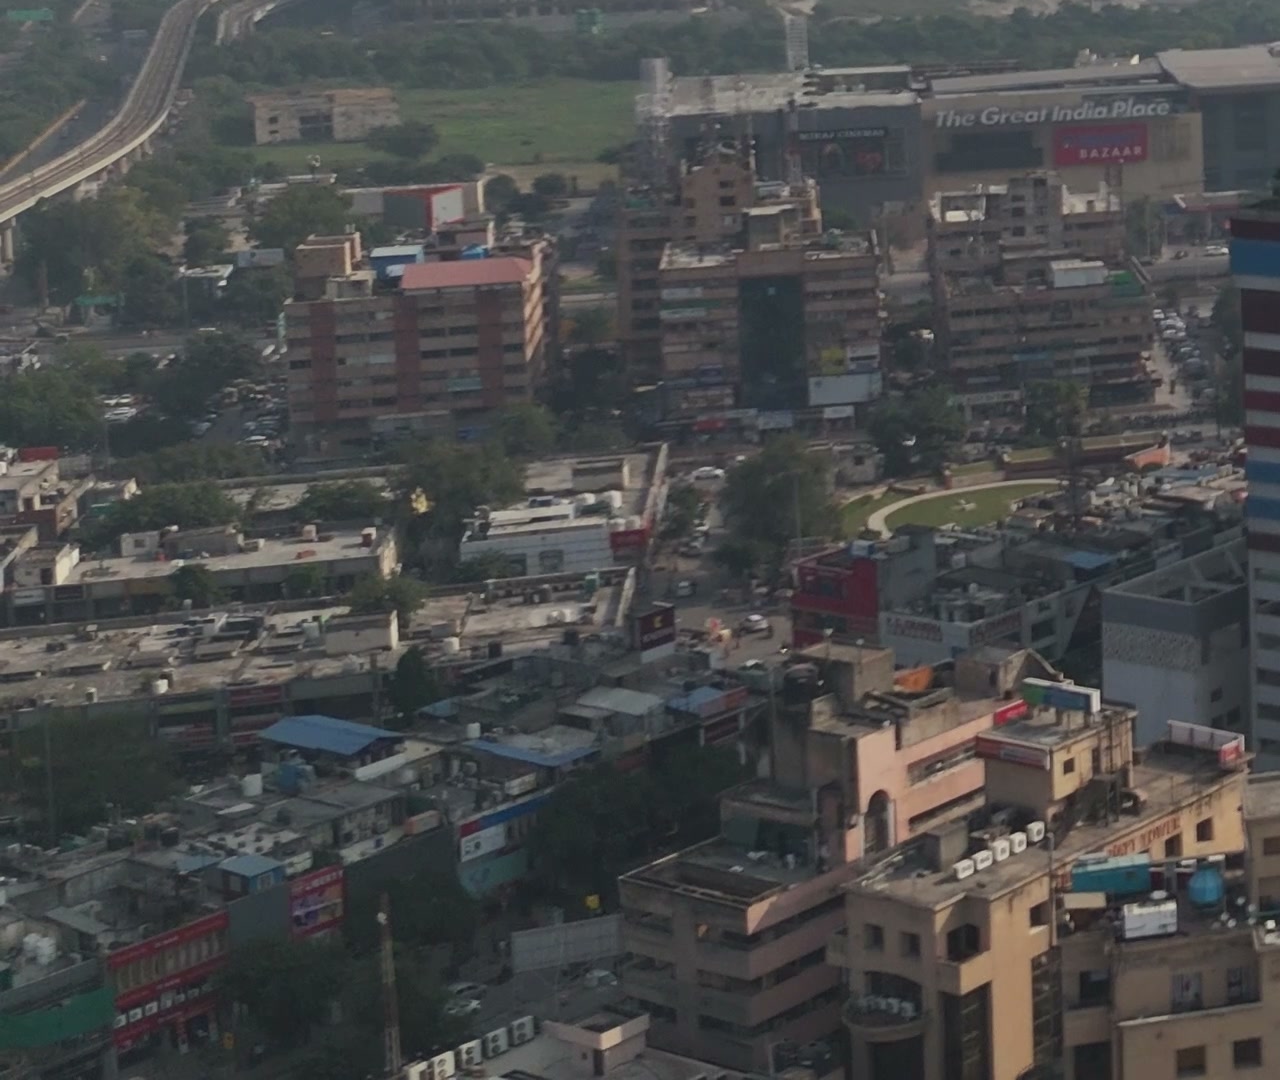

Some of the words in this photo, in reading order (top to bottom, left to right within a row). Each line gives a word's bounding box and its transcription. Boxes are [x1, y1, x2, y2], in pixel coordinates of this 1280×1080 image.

[935, 110, 975, 128] The
[981, 106, 1047, 125] Great
[1051, 103, 1107, 122] India
[1112, 97, 1170, 118] Place
[1080, 146, 1142, 159] BAZAAR
